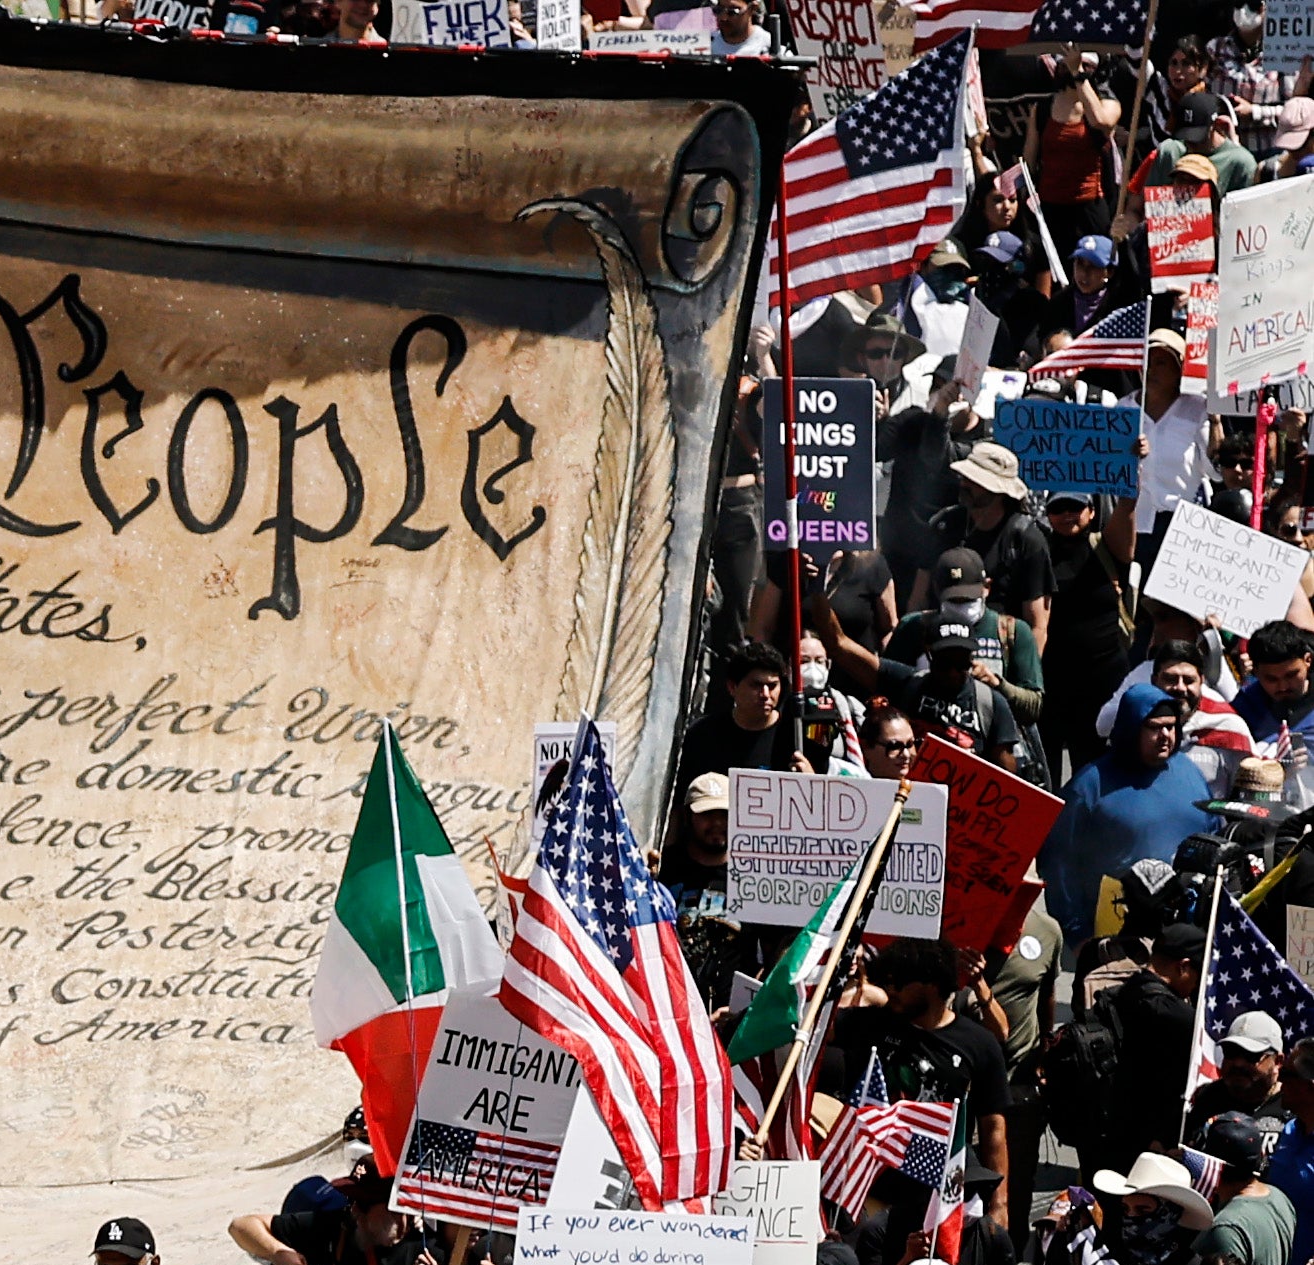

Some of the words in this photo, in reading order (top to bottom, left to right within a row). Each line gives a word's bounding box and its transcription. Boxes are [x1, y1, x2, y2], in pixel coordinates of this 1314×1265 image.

[799, 390, 838, 412] NO
[7, 673, 274, 752] perfect
[74, 750, 326, 800] domestic
[736, 775, 867, 833] END
[34, 1009, 312, 1047] America
[463, 1088, 534, 1133] ARE
[416, 1147, 547, 1200] AMERICA
[528, 1215, 553, 1233] If
[566, 1216, 600, 1239] you
[609, 1219, 653, 1235] ever
[521, 1245, 560, 1261] what
[628, 1248, 649, 1265] do
